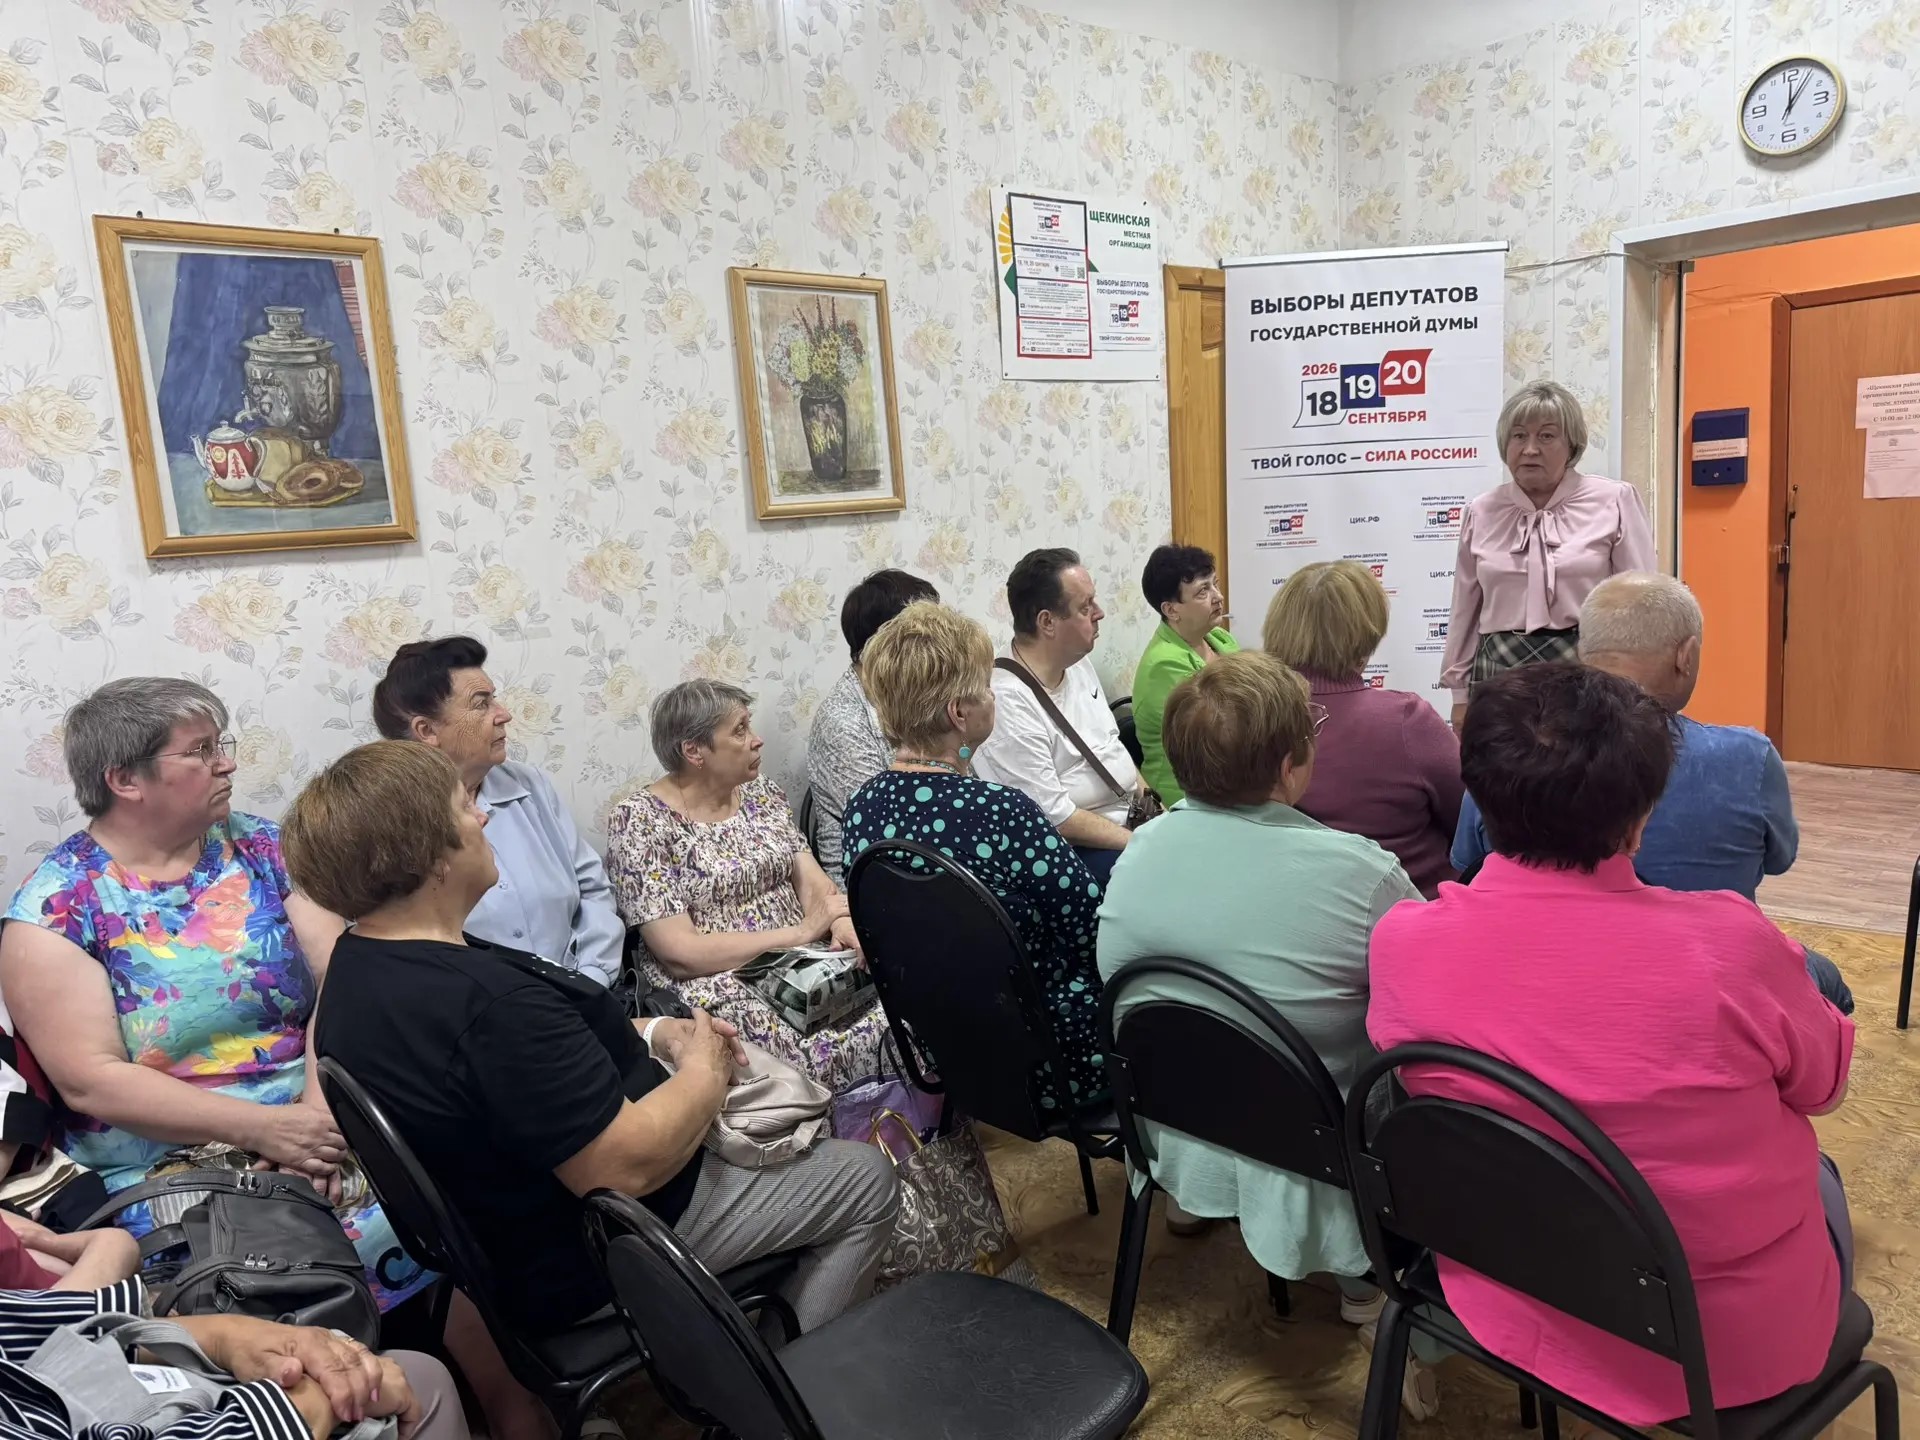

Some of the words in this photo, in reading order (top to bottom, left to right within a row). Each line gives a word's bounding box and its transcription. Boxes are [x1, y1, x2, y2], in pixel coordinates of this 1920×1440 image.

[1782, 69, 1800, 84] 12
[1812, 91, 1830, 106] 3
[1752, 105, 1767, 119] 9
[1781, 128, 1797, 143] 6
[1089, 210, 1150, 227] ЩЕКИНСКАЯ
[1123, 230, 1151, 239] МЕСТНАЯ
[1108, 240, 1151, 250] ОРГАНИЗАЦИЯ
[1120, 280, 1149, 288] ДЕПУТАТОВ
[1250, 293, 1345, 315] ВЫБОРЫ
[1350, 286, 1479, 311] ДЕПУТАТОВ
[1112, 314, 1119, 323] 18
[1120, 309, 1127, 318] 19
[1128, 304, 1138, 314] 20
[1250, 316, 1421, 342] ГОСУДАРСТВЕННОЙ
[1424, 316, 1478, 333] ДУМЫ
[1302, 363, 1338, 376] 2026
[1306, 391, 1338, 417] 18
[1344, 374, 1377, 400] 19
[1383, 360, 1423, 386] 20
[1348, 410, 1427, 424] СЕНТЯБРЯ
[1251, 453, 1292, 470] ТВОЙ
[1296, 452, 1347, 467] ГОЛОС
[1365, 450, 1406, 462] СИЛА
[1410, 447, 1478, 460] РОССИИ!
[1349, 516, 1380, 524] ЦИК.РФ
[1448, 510, 1459, 518] 20
[1281, 521, 1290, 529] 19
[1292, 518, 1302, 526] 20
[1371, 678, 1383, 686] 20
